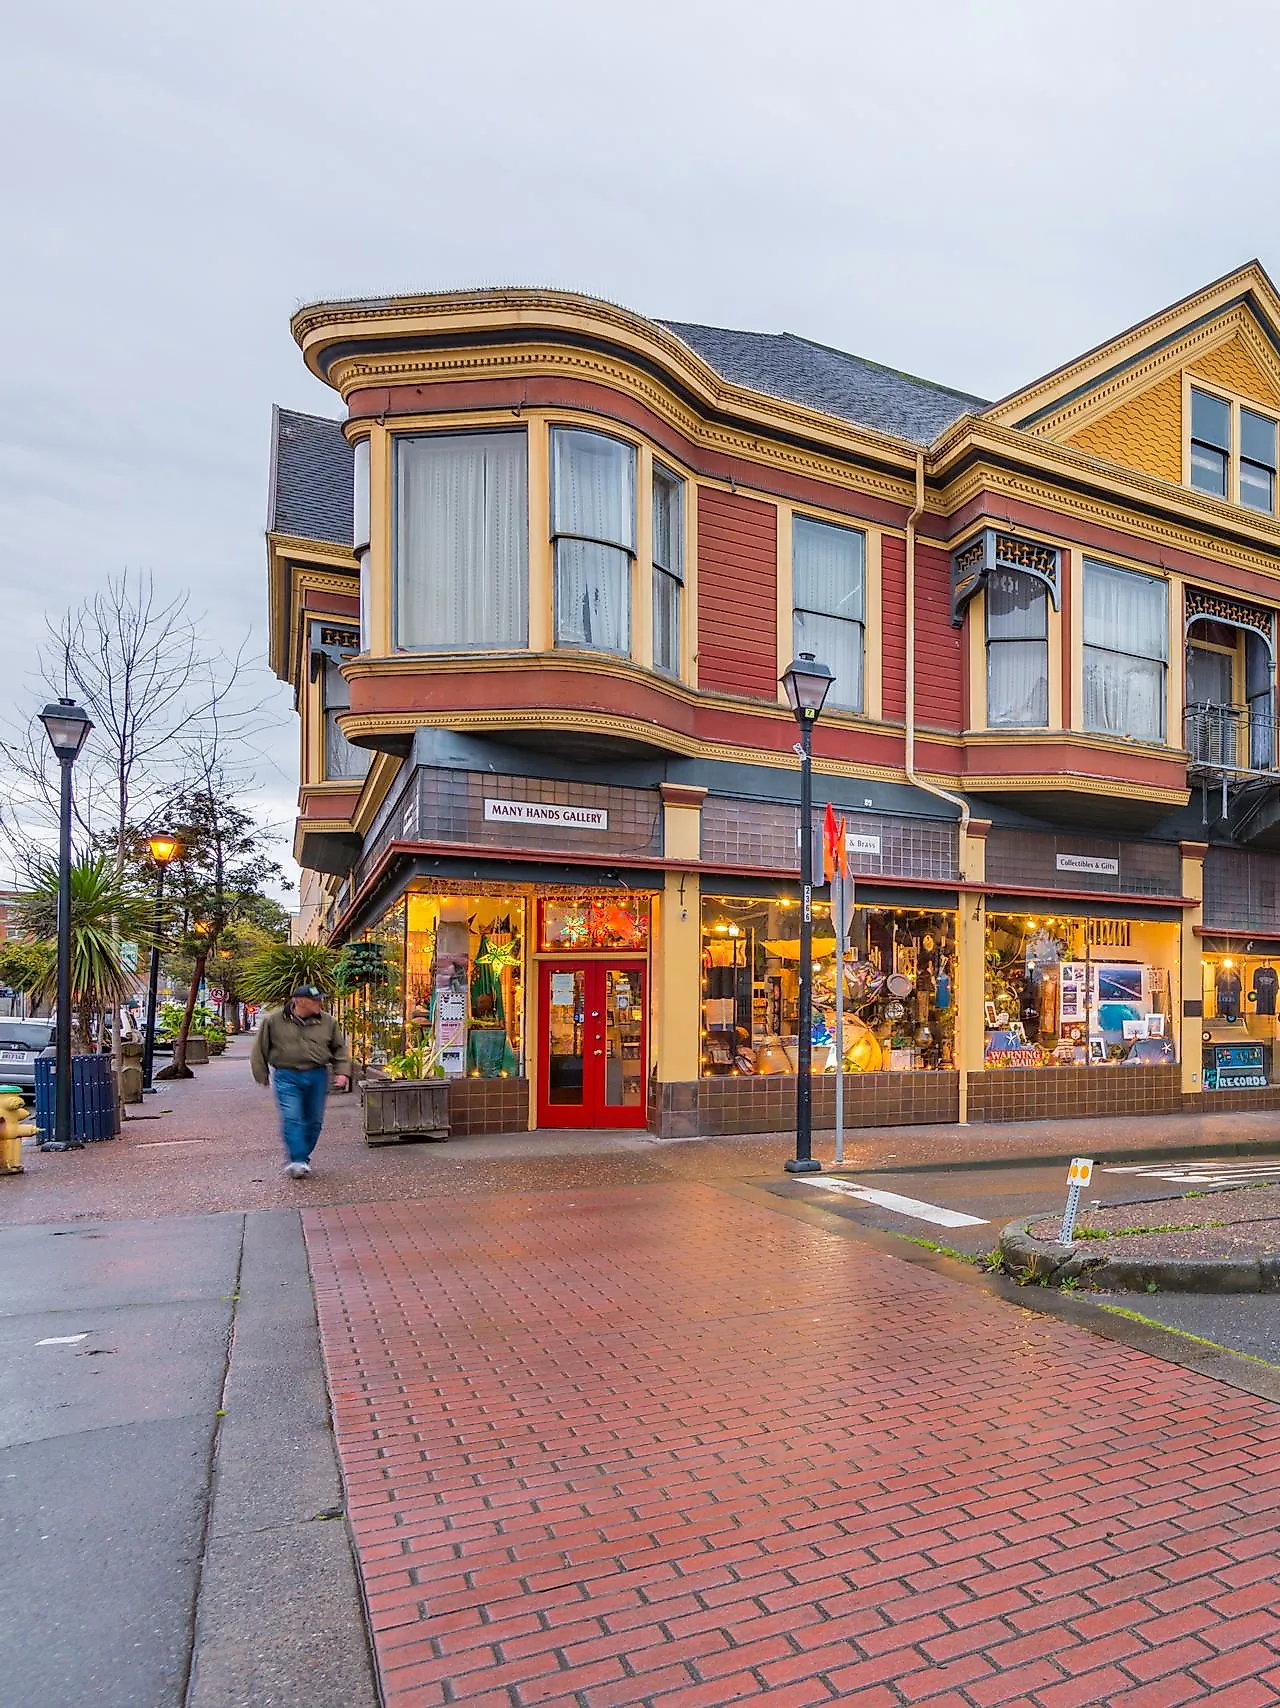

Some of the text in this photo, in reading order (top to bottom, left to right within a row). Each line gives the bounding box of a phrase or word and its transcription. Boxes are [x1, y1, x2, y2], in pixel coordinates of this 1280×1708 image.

[491, 804, 602, 824] MANY HANDS GALLERY
[849, 839, 855, 847] &
[1060, 858, 1094, 868] Collectibles
[1101, 862, 1115, 870] Gifts
[991, 1050, 1041, 1059] WARNING
[1219, 1075, 1267, 1087] RECORDS
